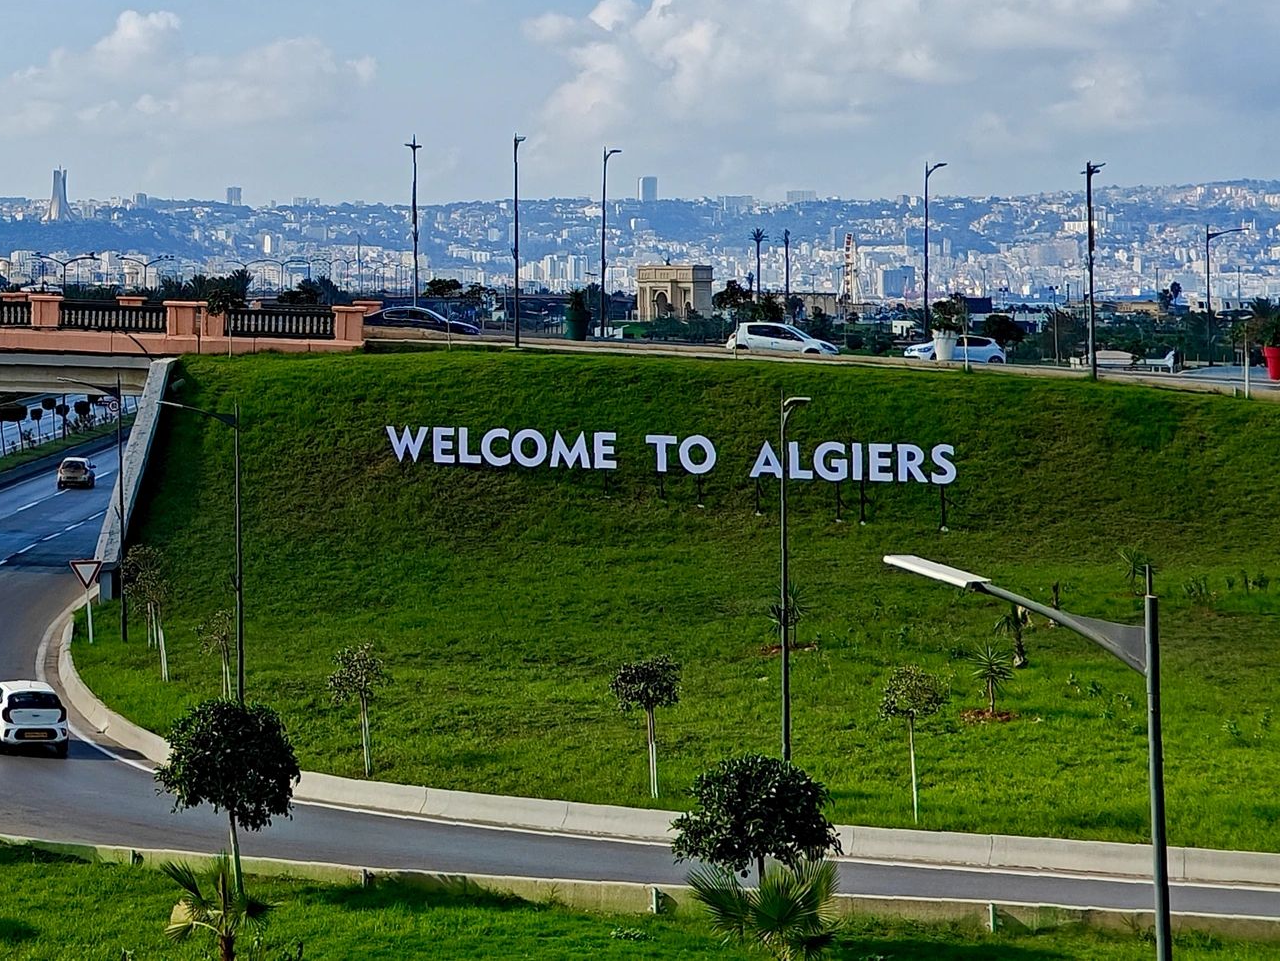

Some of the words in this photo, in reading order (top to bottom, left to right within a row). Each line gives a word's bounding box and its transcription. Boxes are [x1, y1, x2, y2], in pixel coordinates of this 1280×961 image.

[385, 425, 617, 469] WELCOME
[645, 434, 717, 474] TO
[749, 440, 957, 484] ALGIERS
